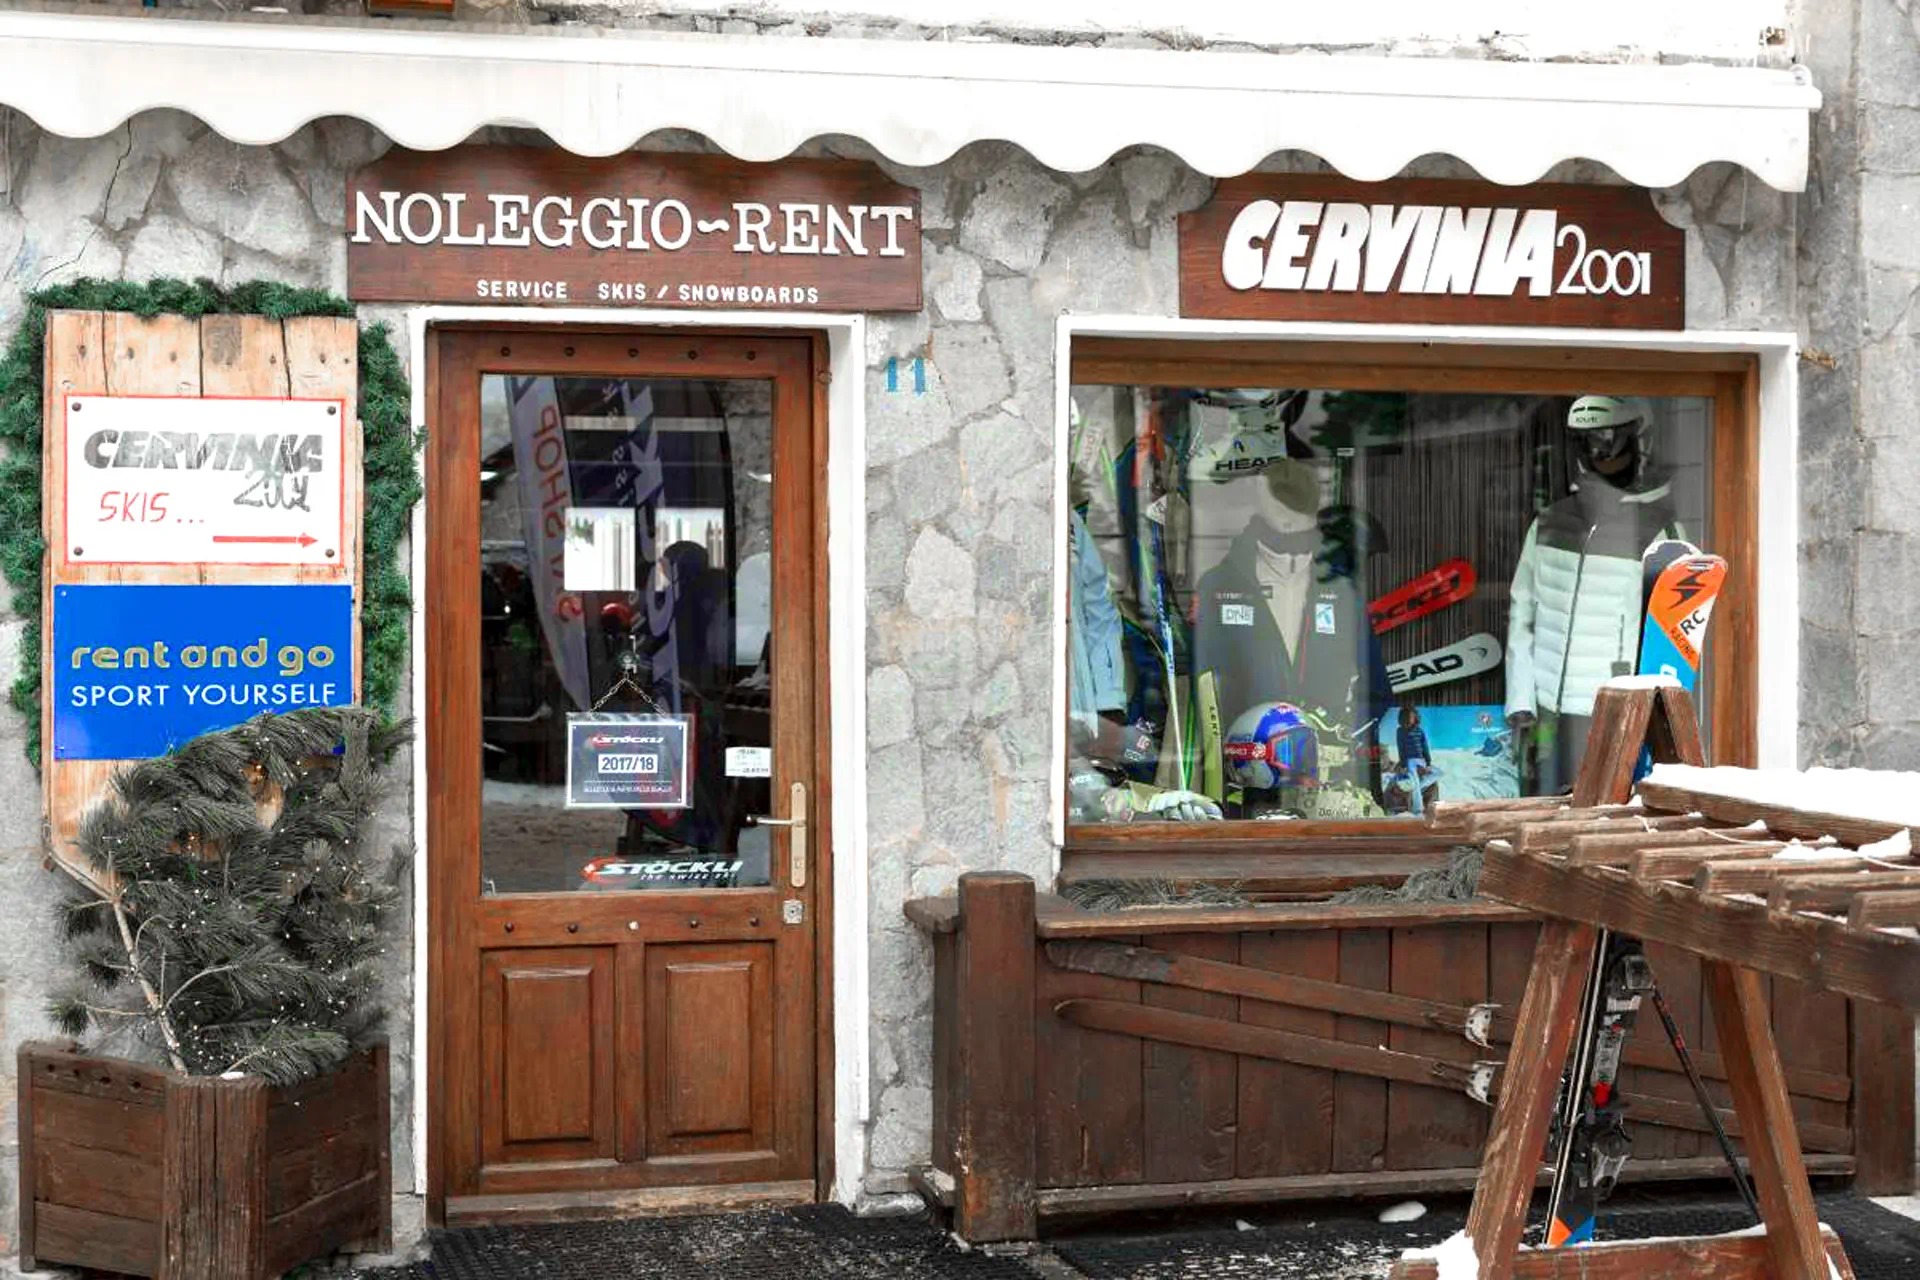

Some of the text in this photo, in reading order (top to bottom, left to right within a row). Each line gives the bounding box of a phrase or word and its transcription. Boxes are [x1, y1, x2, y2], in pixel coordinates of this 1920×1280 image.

[1222, 200, 1650, 296] CERVINIA 2001
[477, 279, 567, 299] SERVICE
[598, 282, 646, 300] SKIS
[679, 284, 818, 304] SNOWBOARDS
[887, 356, 926, 394] 11
[84, 429, 323, 473] CERVINIA
[1680, 610, 1706, 635] RC
[72, 638, 334, 676] rent and go
[71, 683, 336, 706] SPORT YOURSELF
[601, 756, 655, 771] 2017/18
[597, 859, 744, 875] STÖCKLI
